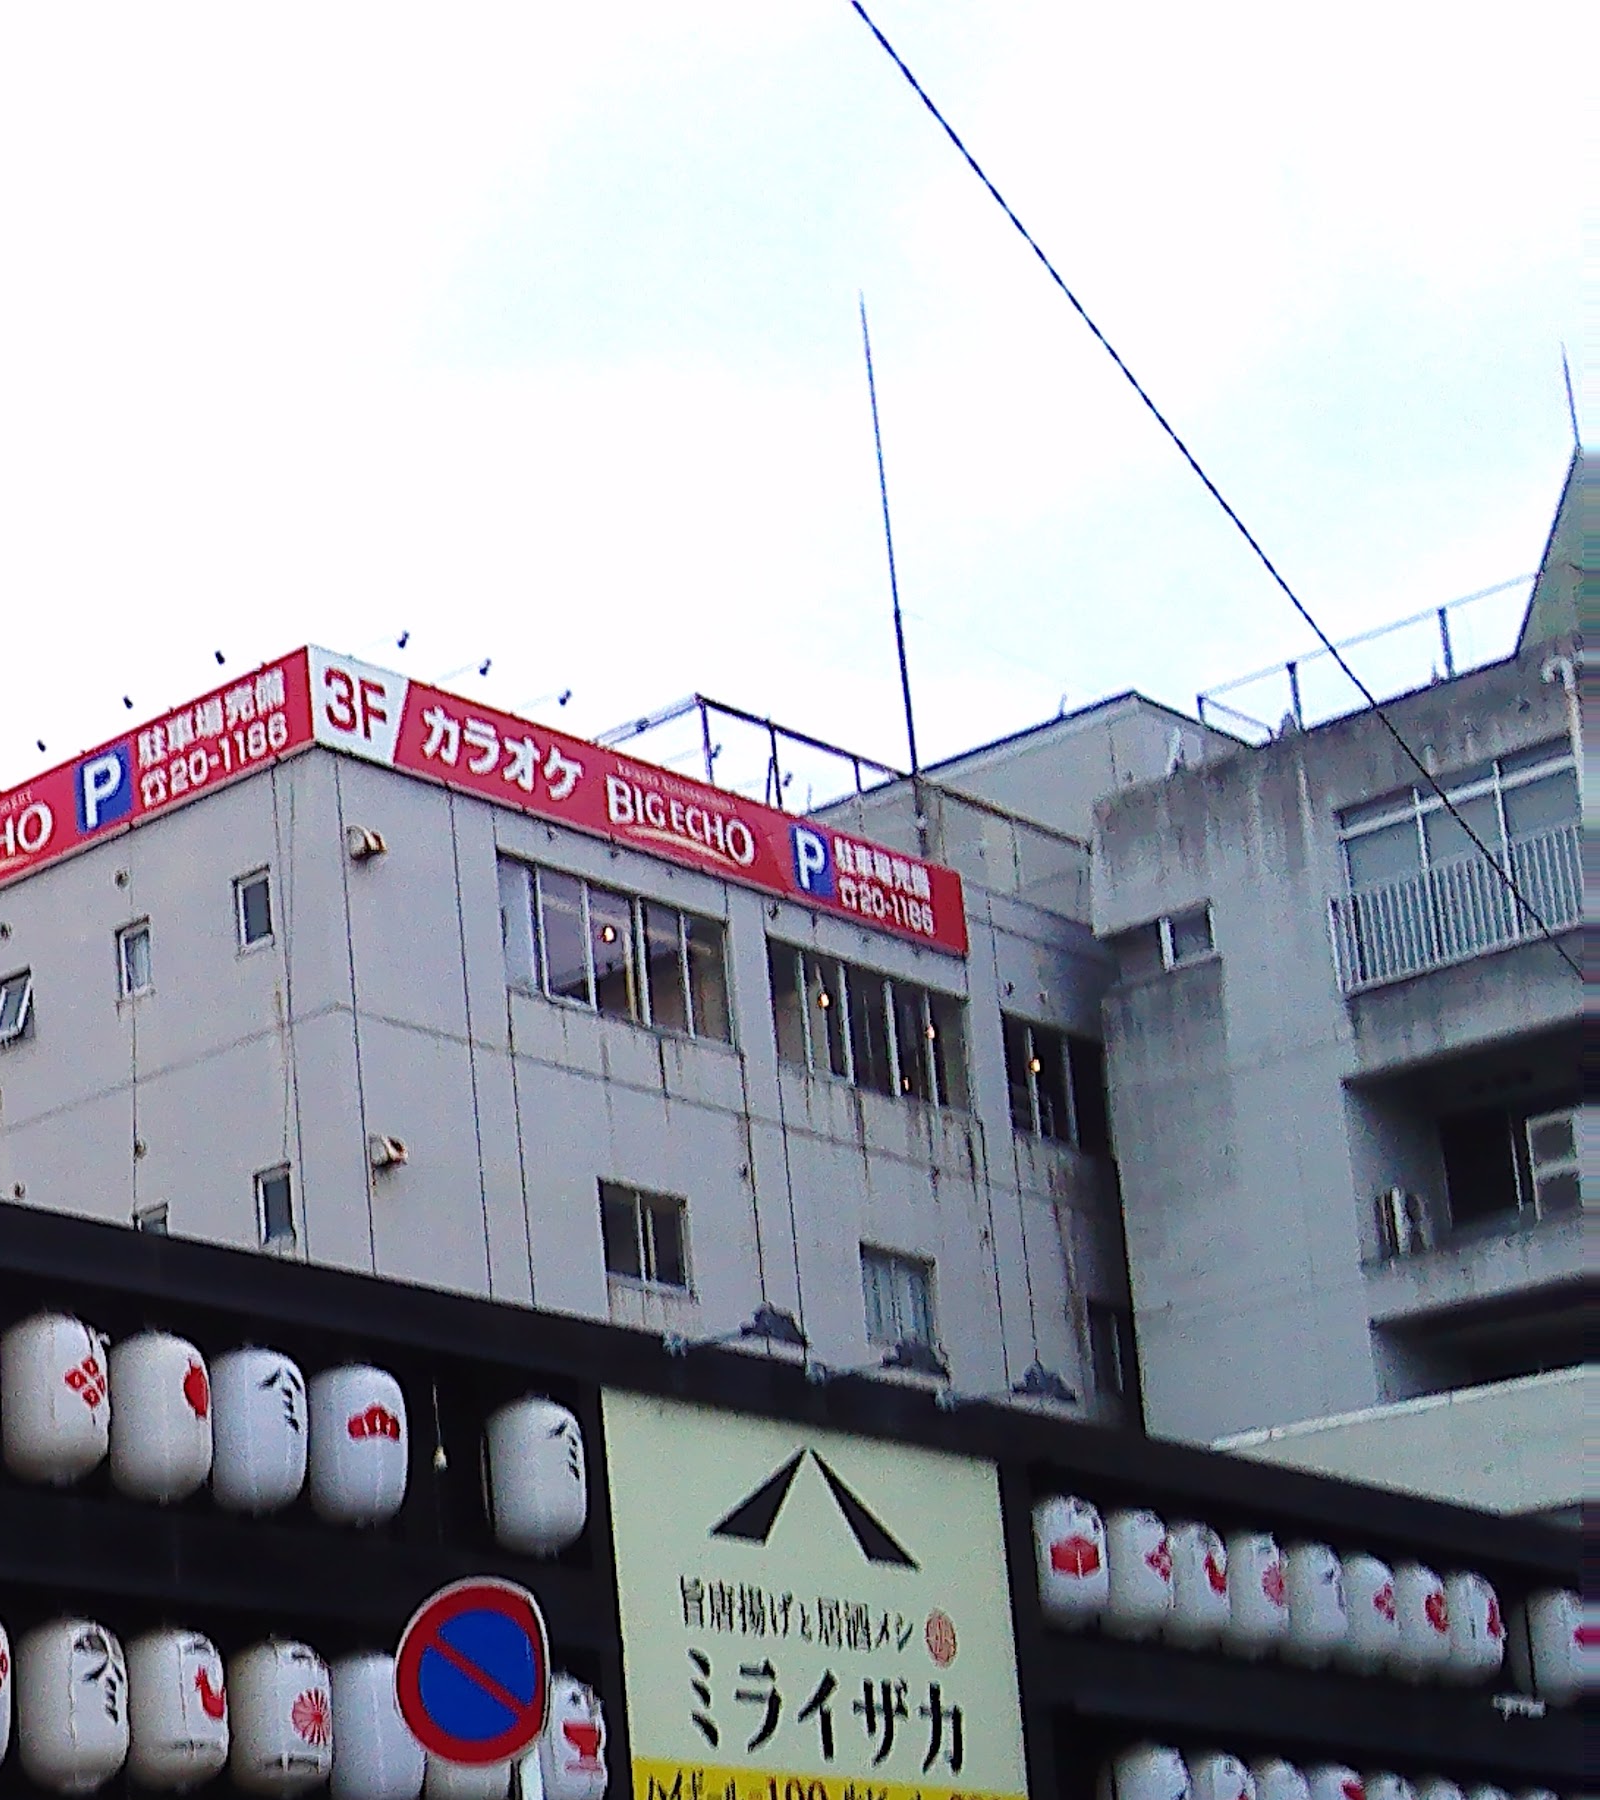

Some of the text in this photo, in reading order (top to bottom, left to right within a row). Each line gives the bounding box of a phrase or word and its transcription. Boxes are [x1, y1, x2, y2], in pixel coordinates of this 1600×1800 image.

[324, 666, 387, 742] 3F
[421, 704, 585, 801] カラオケ
[606, 772, 667, 828] BIG
[669, 796, 755, 867] ECHO
[686, 1647, 964, 1776] ミライザカ
